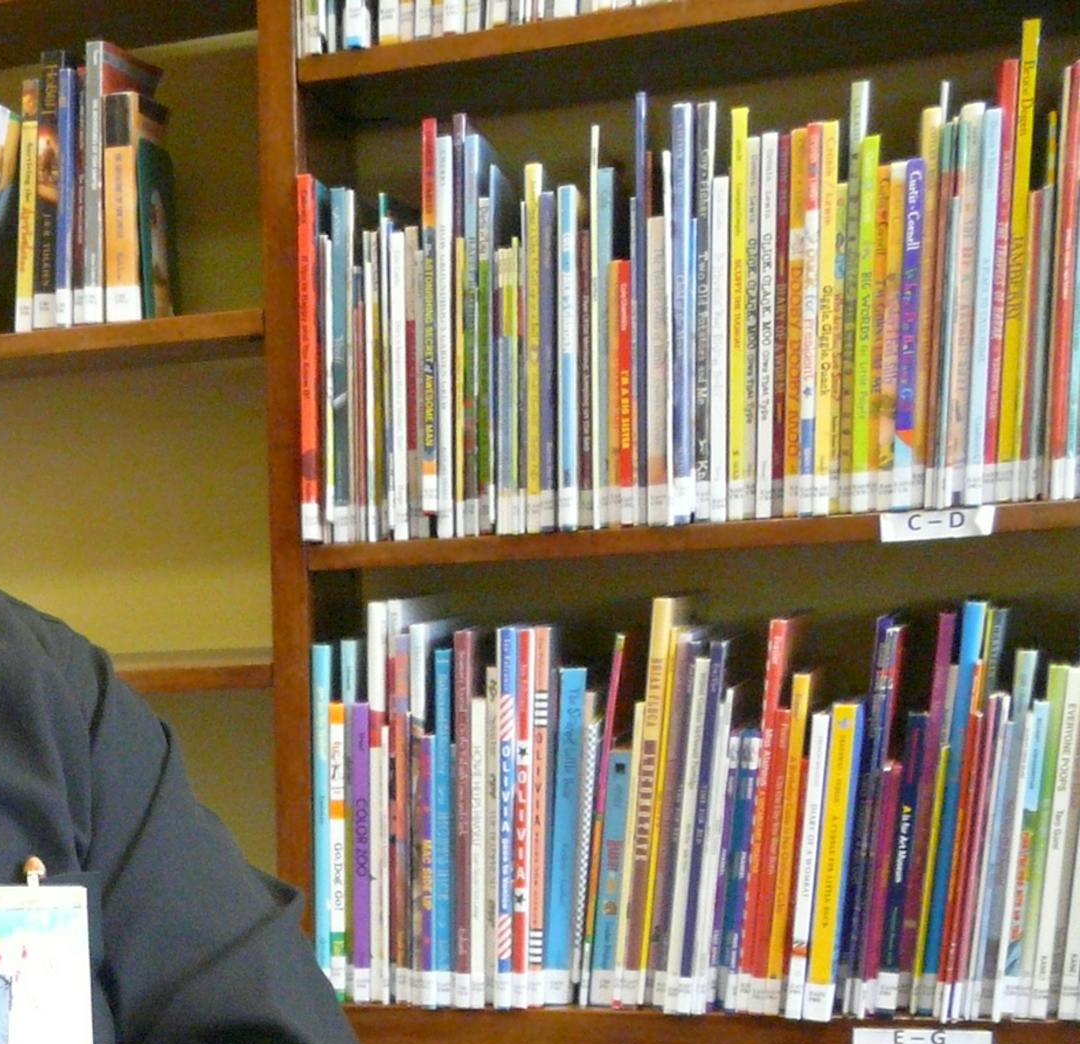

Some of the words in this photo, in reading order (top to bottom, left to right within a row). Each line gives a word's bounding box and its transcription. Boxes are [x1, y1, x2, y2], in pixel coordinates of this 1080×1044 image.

[1022, 60, 1035, 95] Bruce
[1019, 98, 1033, 136] Degen
[908, 171, 923, 204] Curtis
[906, 211, 922, 252] Cornell
[698, 250, 708, 280] Two
[1006, 234, 1024, 321] JAMBERRY
[424, 258, 434, 323] ASTONISHING
[860, 295, 870, 342] WORDS
[424, 326, 434, 363] SECRET
[425, 374, 434, 421] AWESOME
[426, 424, 434, 447] MAN
[1063, 703, 1076, 756] EVERYONE
[501, 743, 513, 833] OLIVIA
[533, 732, 543, 827] OLIVIA
[1057, 757, 1070, 792] POOPS
[355, 798, 368, 844] COLOR
[517, 770, 528, 881] OLIVIA
[903, 805, 913, 814] A
[898, 835, 908, 850] Art
[900, 822, 910, 834] for
[355, 848, 368, 877] ZOO
[422, 839, 432, 864] MAC
[894, 851, 905, 884] Museum
[422, 895, 432, 911] UP
